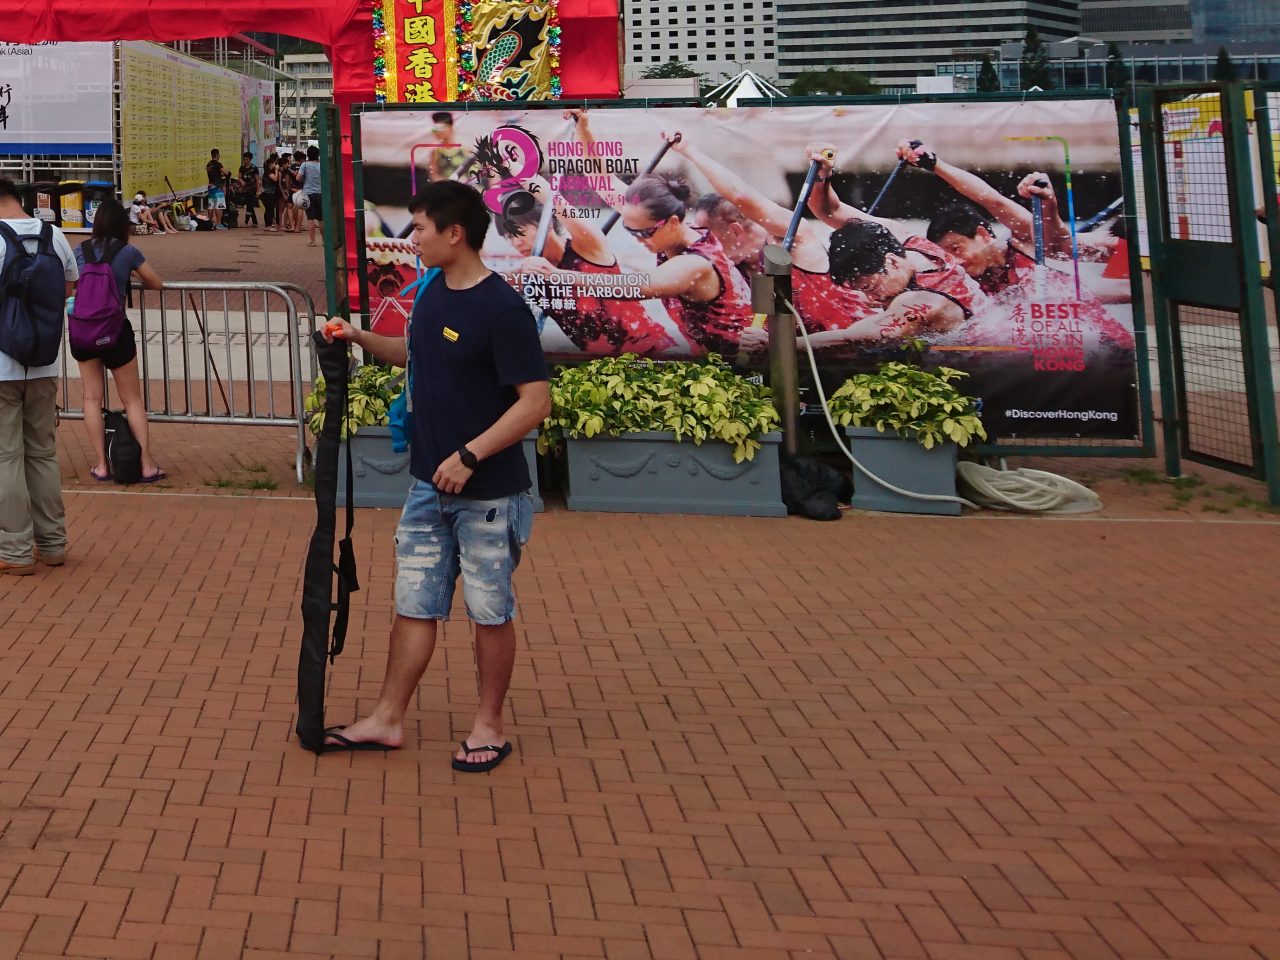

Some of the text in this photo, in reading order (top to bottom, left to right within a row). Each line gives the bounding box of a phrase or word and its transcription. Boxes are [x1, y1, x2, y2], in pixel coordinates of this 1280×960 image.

[7, 47, 33, 57] (Asia)
[548, 141, 623, 157] HONG KONG
[549, 158, 639, 174] DRAGON BOAT
[551, 208, 601, 219] 2-4.6.2017
[580, 273, 650, 286] TRADITION
[524, 285, 546, 297] ON
[550, 285, 573, 298] THE
[577, 286, 646, 299] HARBOUR.
[1030, 303, 1082, 320] BEST
[1031, 320, 1083, 333] OF ALL
[1031, 333, 1084, 346] IT'S IN
[1032, 346, 1085, 360] HONG
[1034, 359, 1086, 372] KONG
[1005, 409, 1119, 422] #DiscoverHongKong
